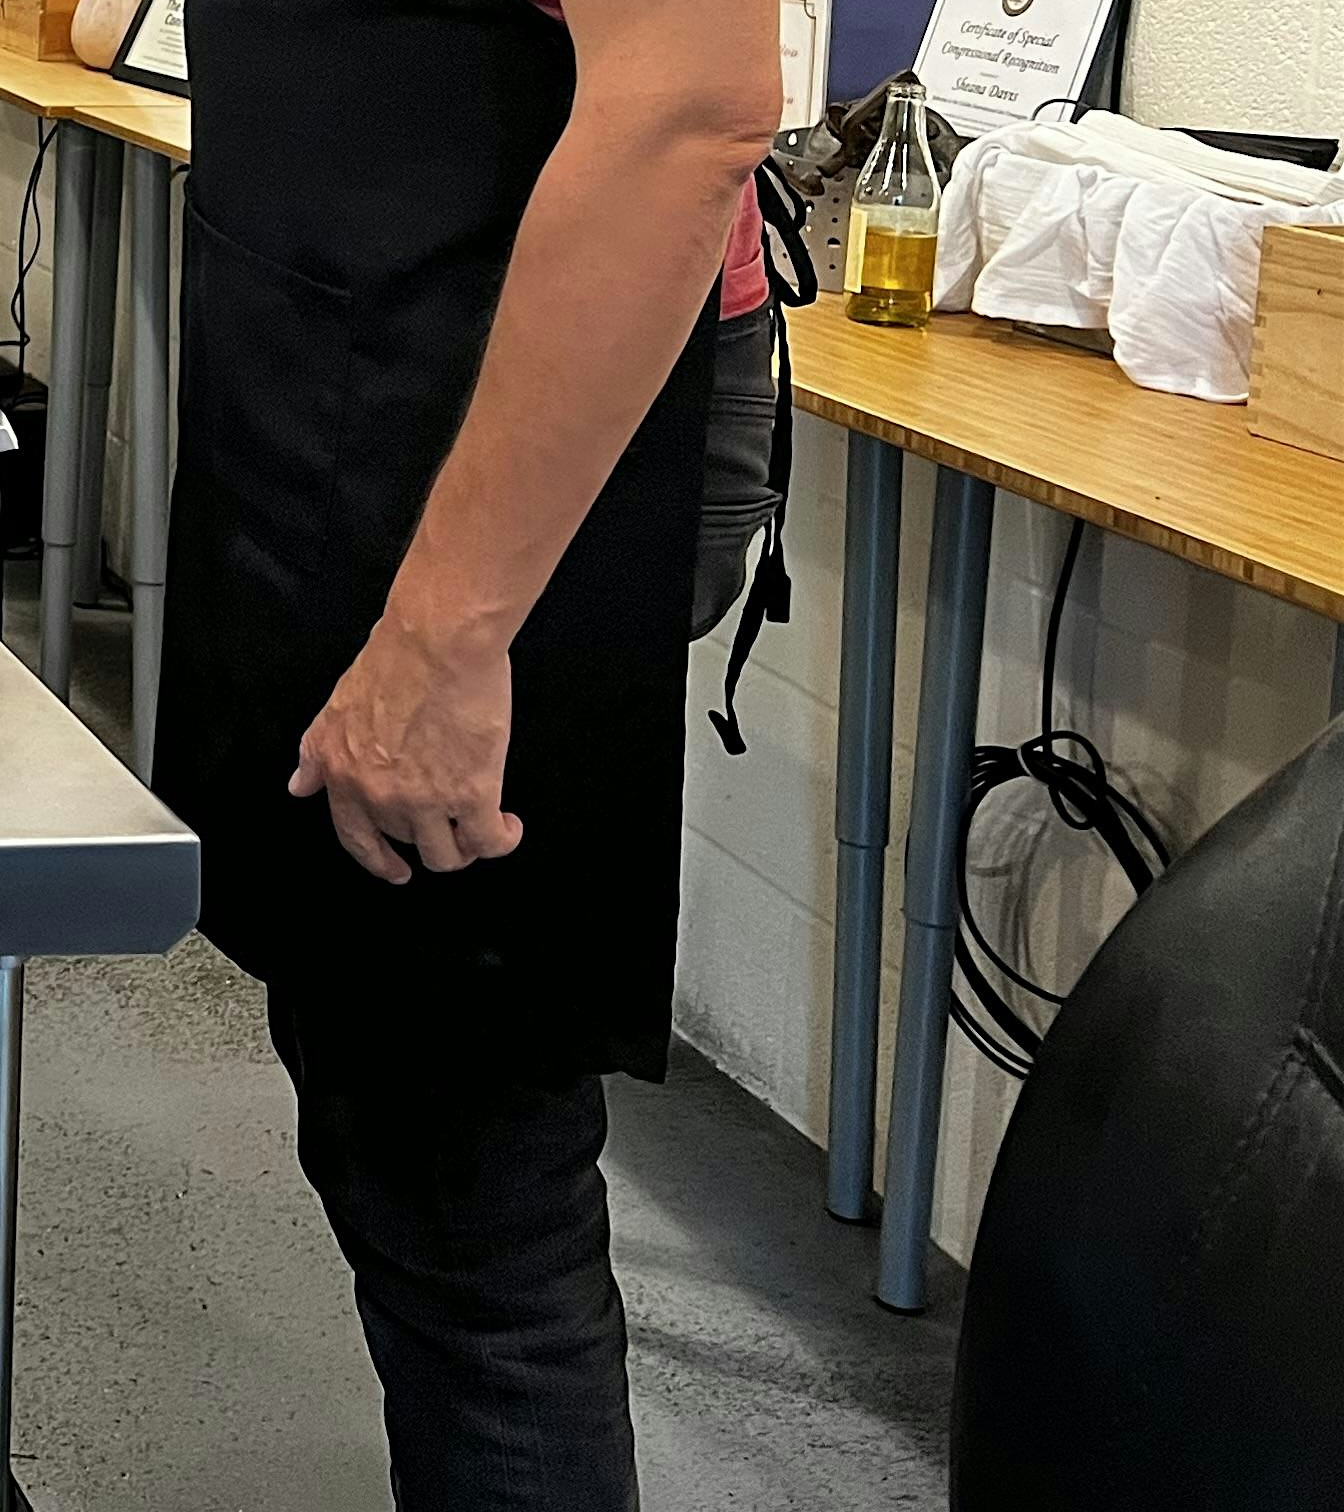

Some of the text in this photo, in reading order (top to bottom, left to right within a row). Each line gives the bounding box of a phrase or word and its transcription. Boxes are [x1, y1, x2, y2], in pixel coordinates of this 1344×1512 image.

[960, 20, 1060, 48] Certificate of Special
[941, 41, 1060, 74] Congressional Recognition
